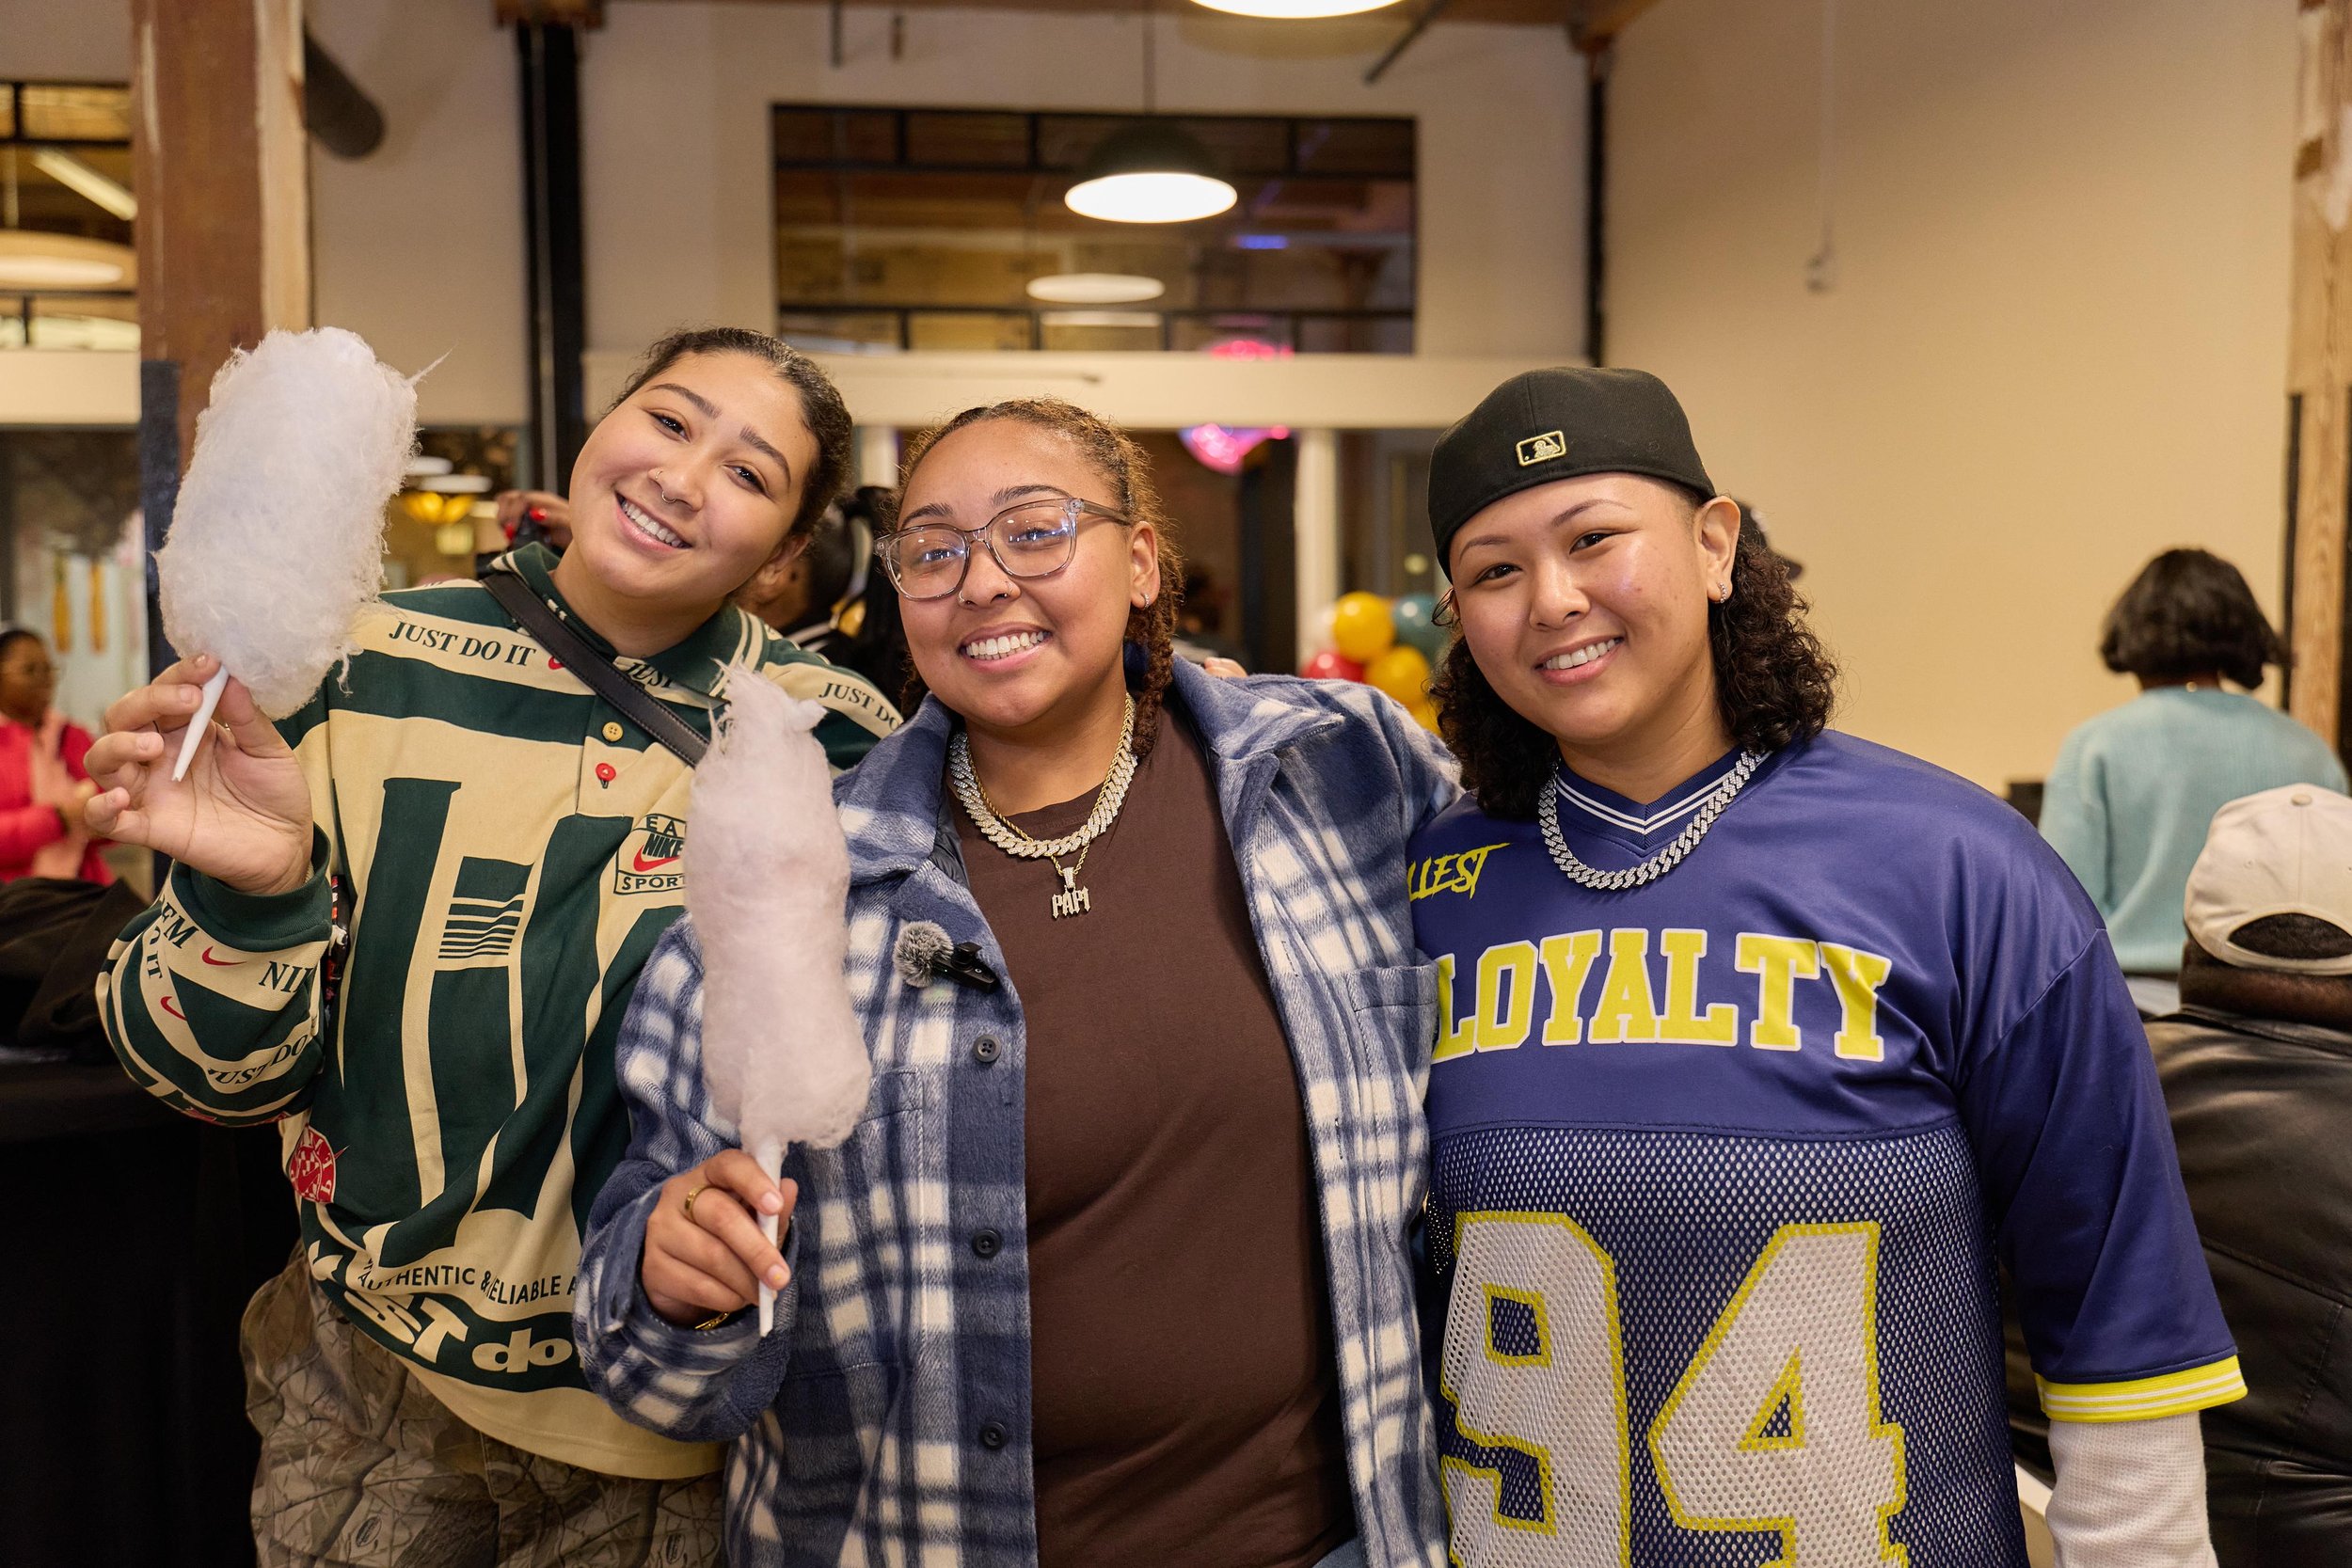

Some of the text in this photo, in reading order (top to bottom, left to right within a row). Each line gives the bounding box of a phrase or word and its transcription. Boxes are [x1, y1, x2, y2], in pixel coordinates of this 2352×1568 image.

[389, 621, 537, 667] JUST DO IT
[818, 682, 875, 711] JUST
[643, 833, 684, 858] NIKE
[1051, 885, 1091, 919] PAPI
[1432, 927, 1892, 1063] LOYALTY
[270, 1034, 309, 1068] DO
[358, 1264, 476, 1291] AUTHENTIC
[485, 1275, 562, 1305] ELIABLE
[471, 1327, 573, 1374] do
[1440, 1210, 1910, 1568] 94
